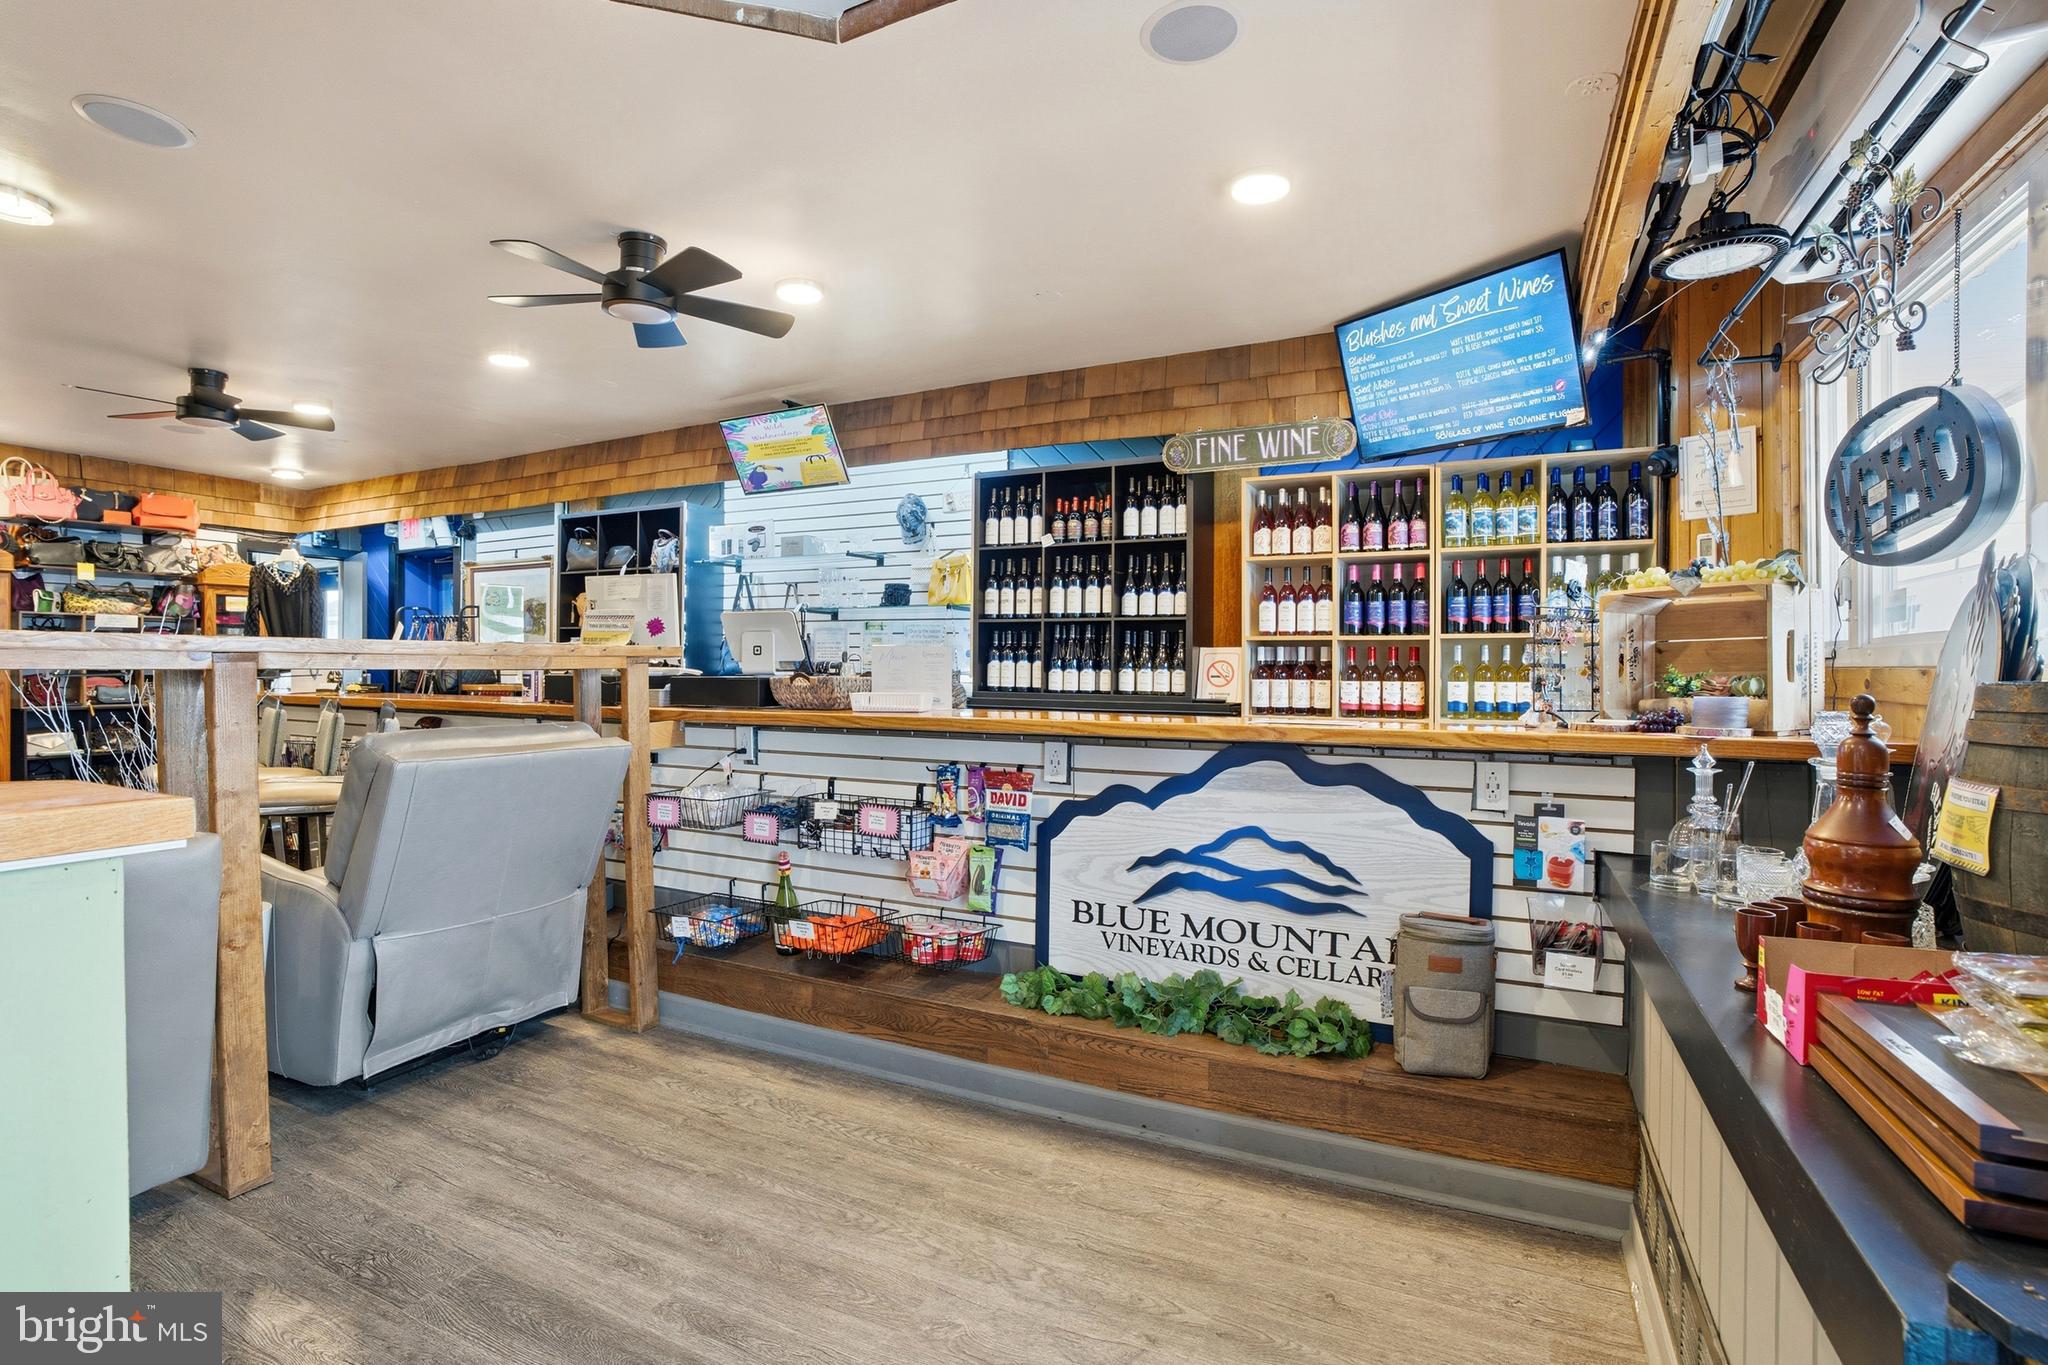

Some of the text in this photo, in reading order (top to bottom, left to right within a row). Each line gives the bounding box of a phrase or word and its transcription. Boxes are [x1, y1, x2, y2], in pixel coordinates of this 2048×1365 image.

[1346, 273, 1555, 352] Blushes and Sweet Wines
[1484, 422, 1504, 431] WINE
[1196, 426, 1321, 466] FINE WINE
[990, 791, 1028, 807] DAVID
[992, 812, 1020, 821] ORIGINAL
[1070, 899, 1397, 965] BLUE MOUNTAI
[1100, 930, 1382, 988] VINEYARDS & CELLAR
[1941, 998, 1970, 1008] KIN
